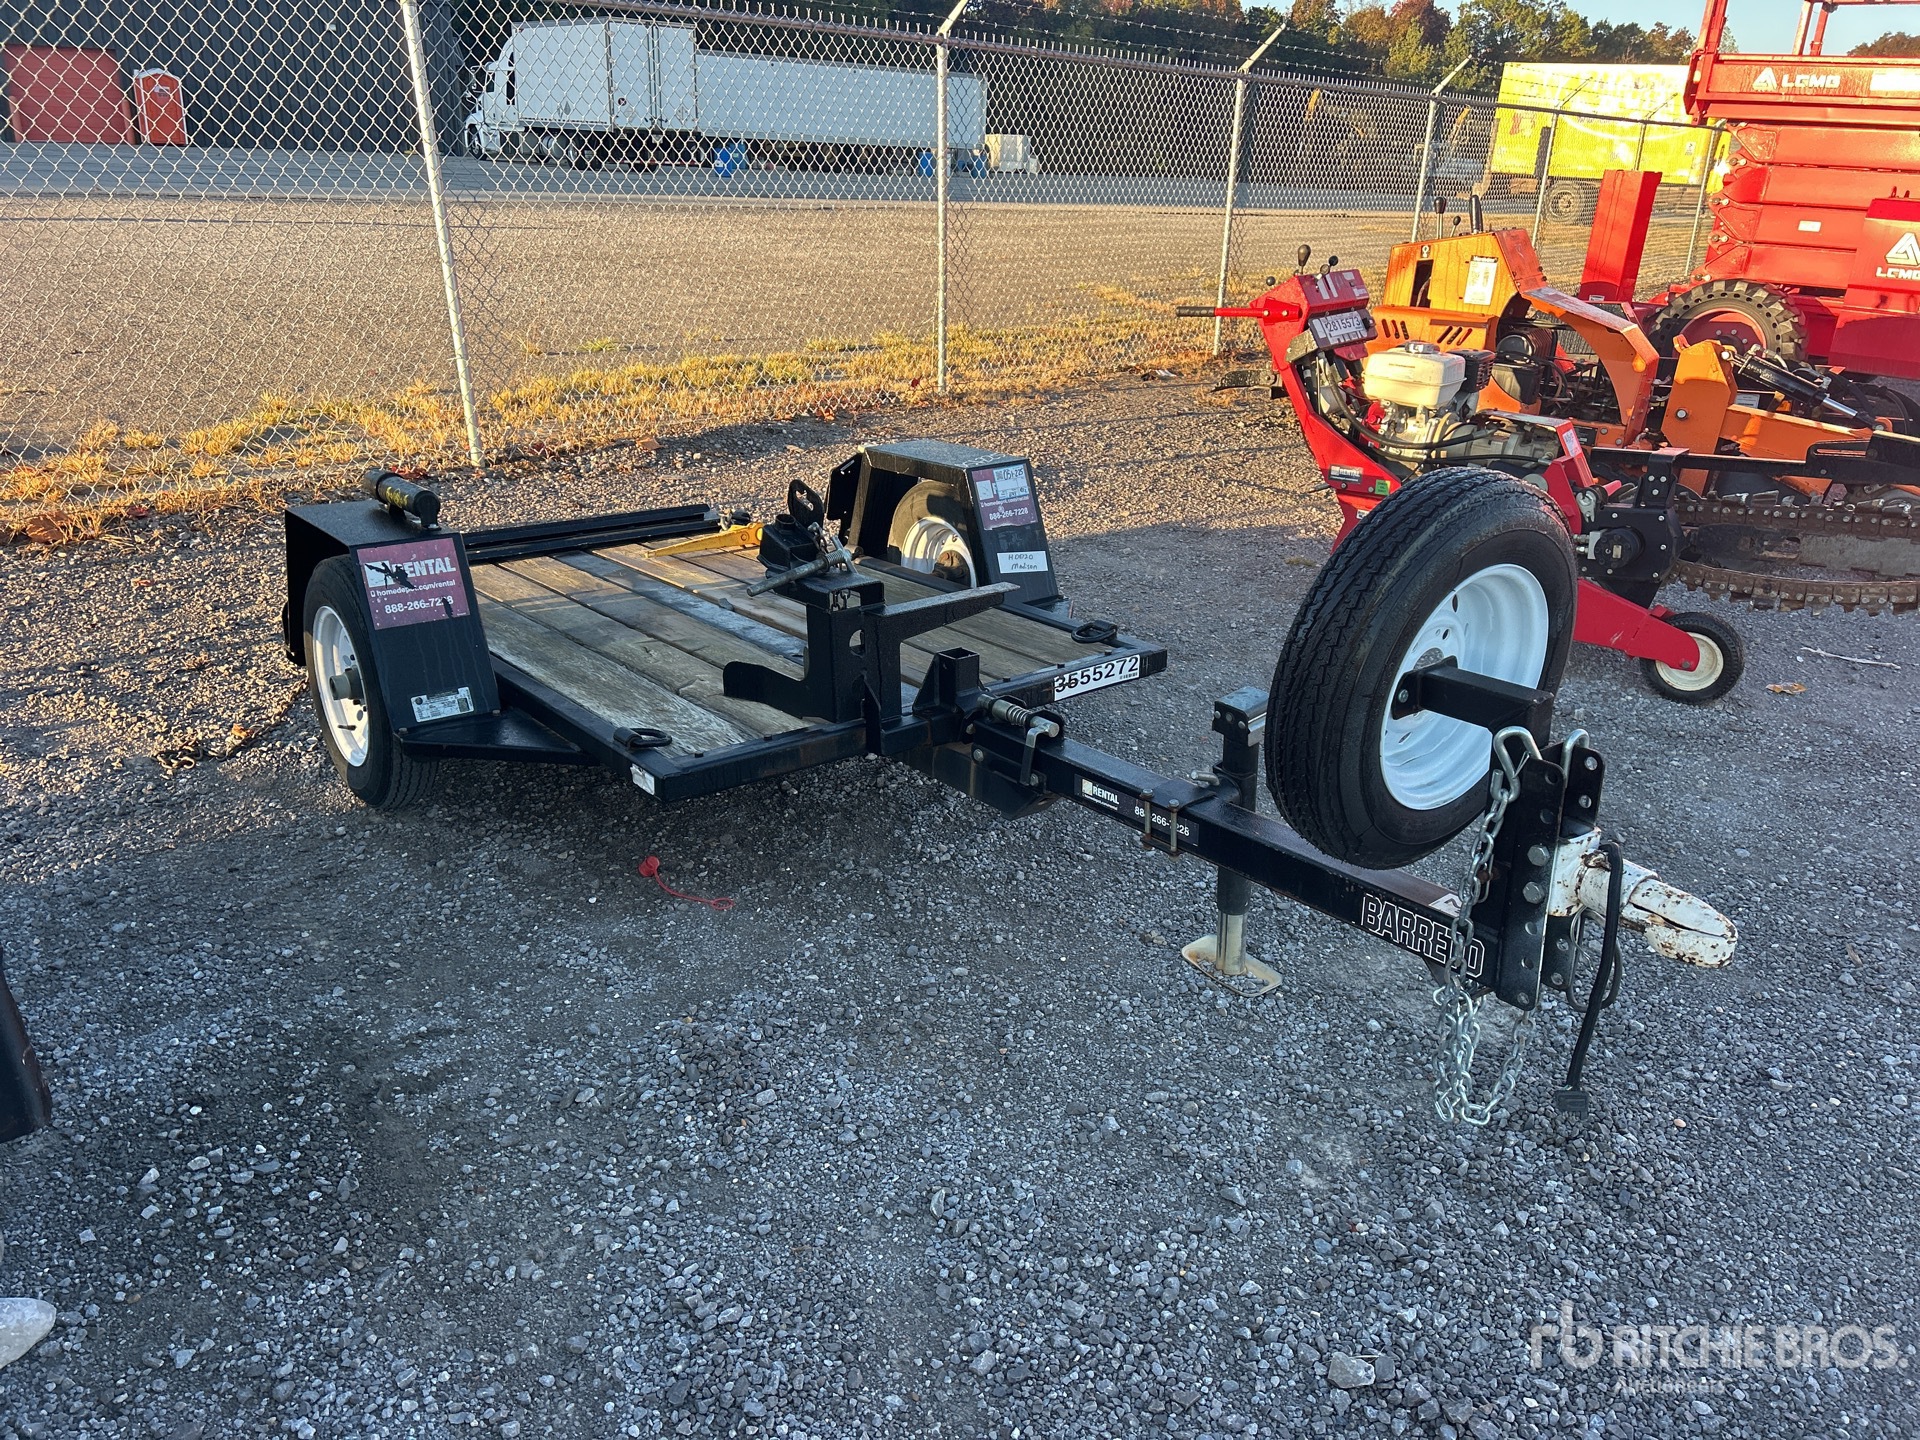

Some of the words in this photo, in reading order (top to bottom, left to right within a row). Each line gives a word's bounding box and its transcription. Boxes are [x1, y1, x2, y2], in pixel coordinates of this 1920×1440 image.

[1326, 316, 1361, 332] 2815573
[385, 595, 454, 614] 888-266-728
[1055, 656, 1139, 693] 3555272
[1092, 785, 1119, 805] RENTAL
